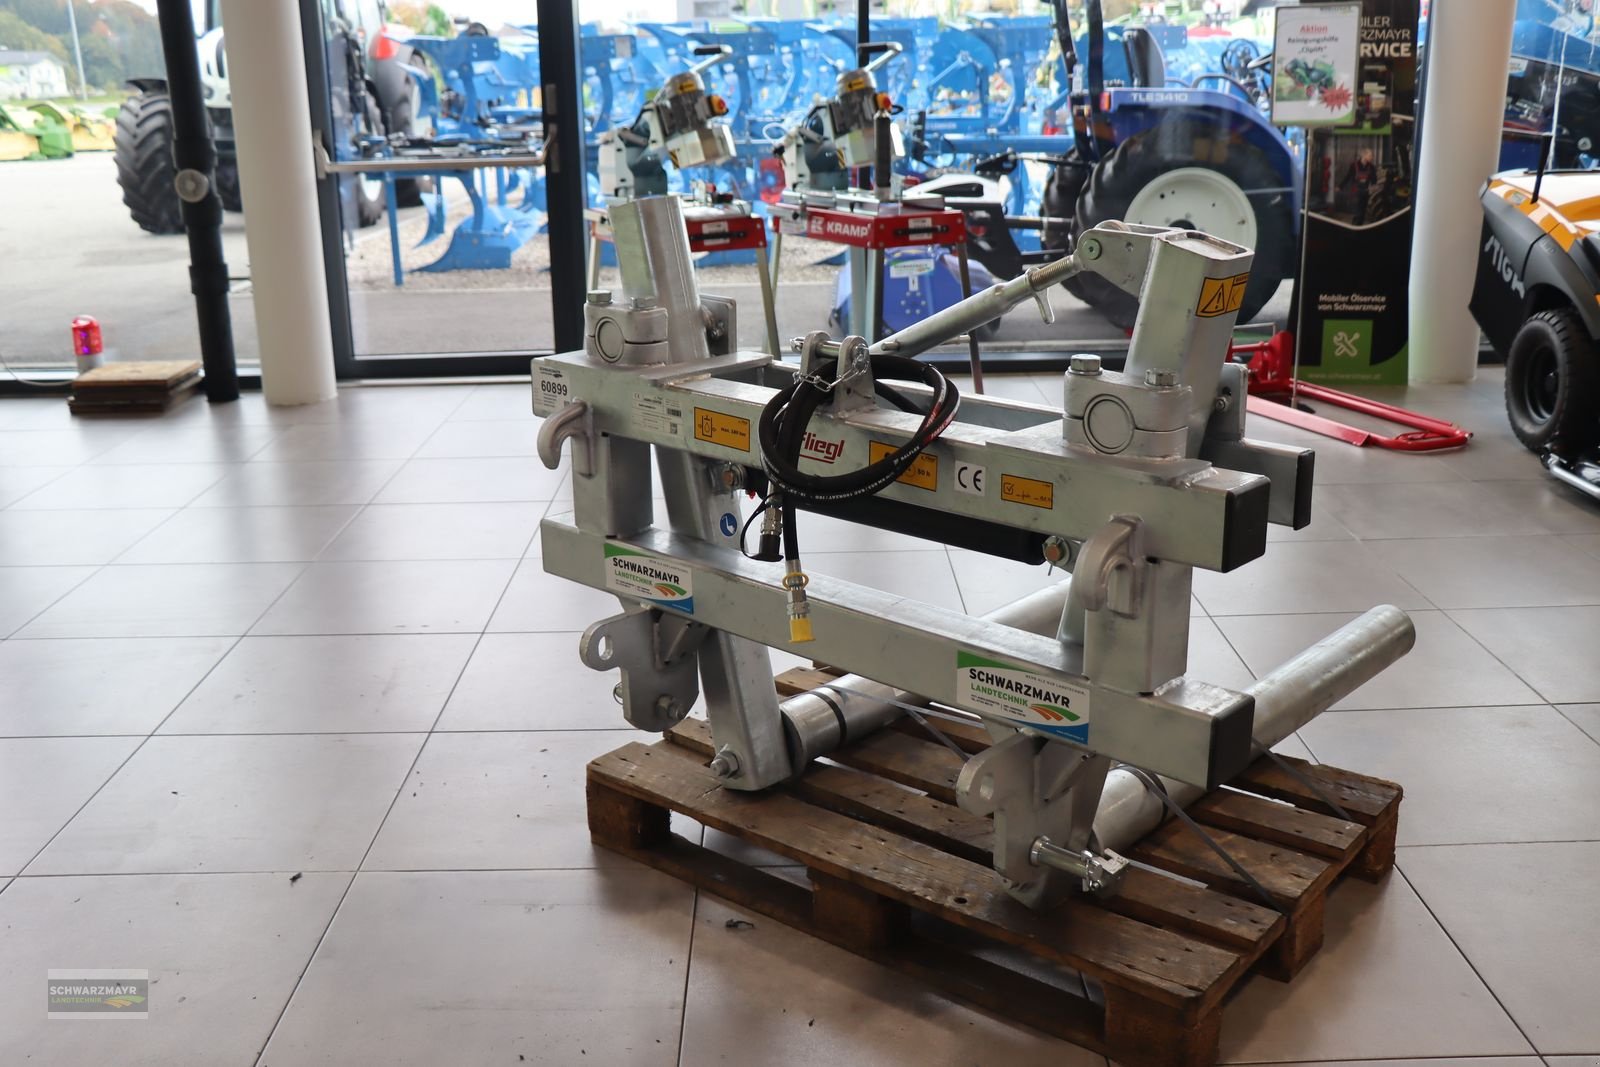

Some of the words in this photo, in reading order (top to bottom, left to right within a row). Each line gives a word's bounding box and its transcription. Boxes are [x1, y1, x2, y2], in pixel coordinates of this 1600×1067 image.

[1300, 25, 1328, 33] Aktion
[1360, 43, 1411, 57] RVICE
[827, 221, 868, 238] KRAMP
[1319, 293, 1349, 303] Mobiler
[1318, 303, 1332, 311] von
[1333, 302, 1387, 313] Schwarzmayr
[541, 380, 568, 396] 60899
[612, 557, 680, 585] SCHWARZMAYR
[614, 569, 653, 586] LANDTECHNIK
[969, 667, 1071, 708] SCHWARZMAYR
[970, 683, 1029, 707] LANDTECHNIK
